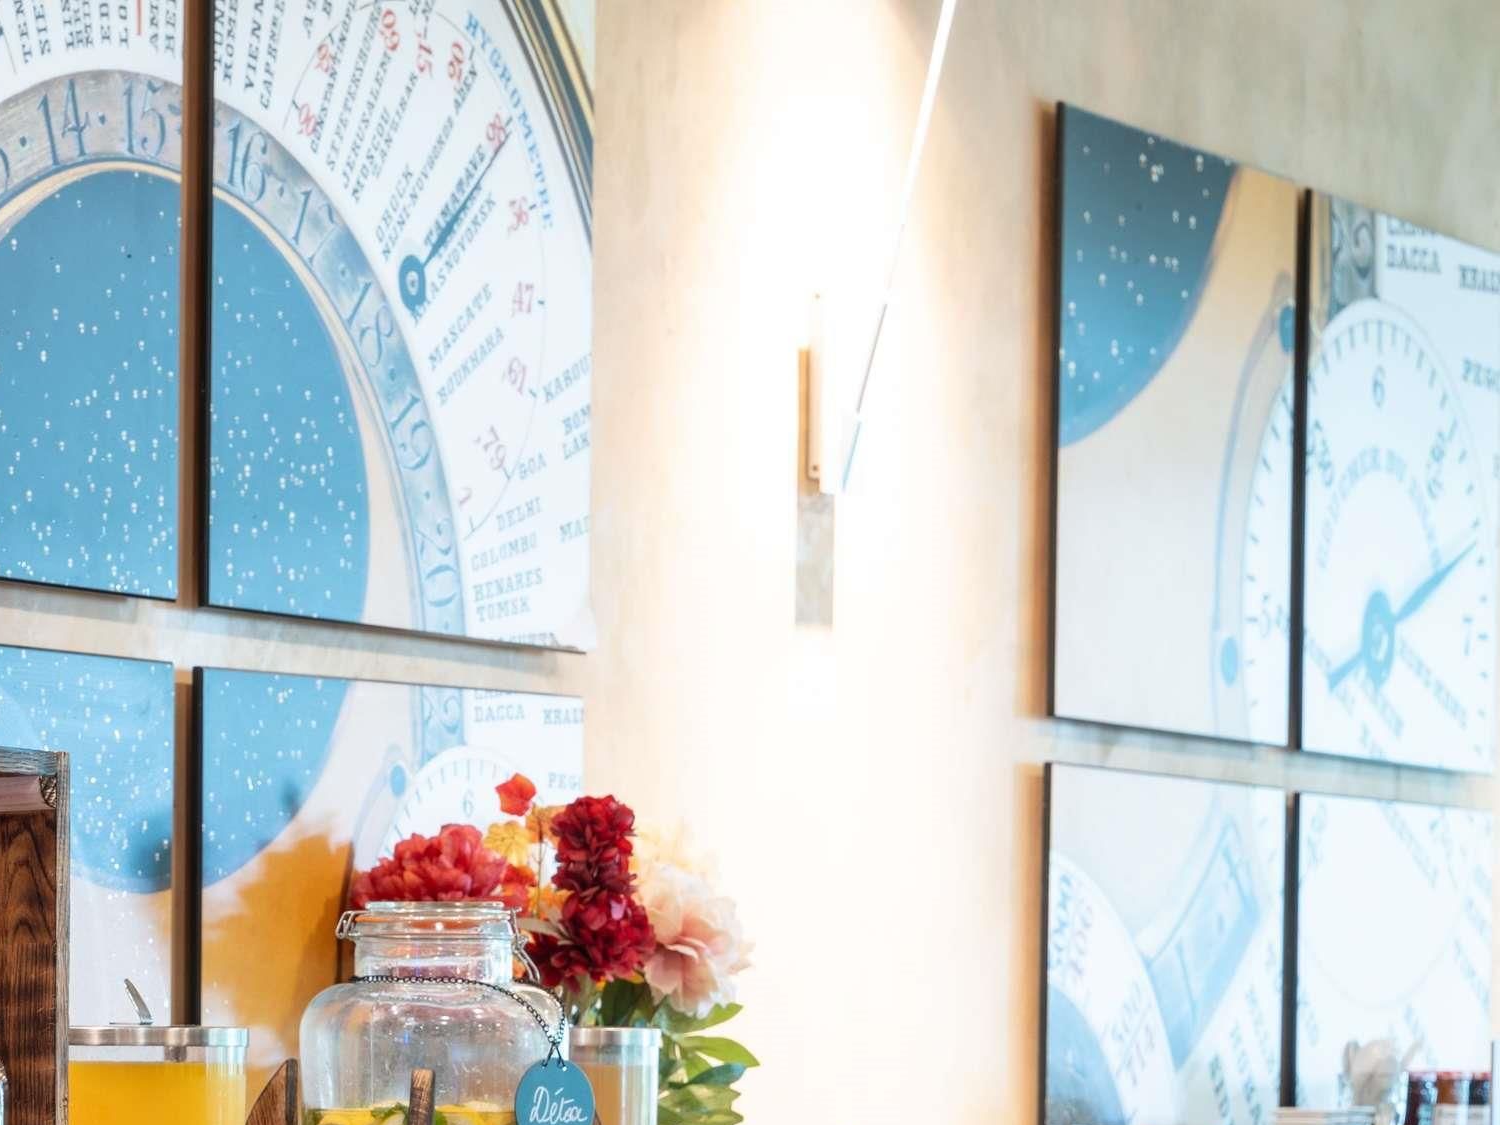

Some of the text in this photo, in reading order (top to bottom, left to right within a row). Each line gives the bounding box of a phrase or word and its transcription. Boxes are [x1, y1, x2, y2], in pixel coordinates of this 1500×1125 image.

[36, 78, 90, 168] 14
[226, 117, 269, 205] 16
[543, 353, 592, 402] KABOU
[496, 496, 543, 531] DELHI
[470, 532, 538, 572] COLOMBO
[473, 568, 543, 603] BENARES
